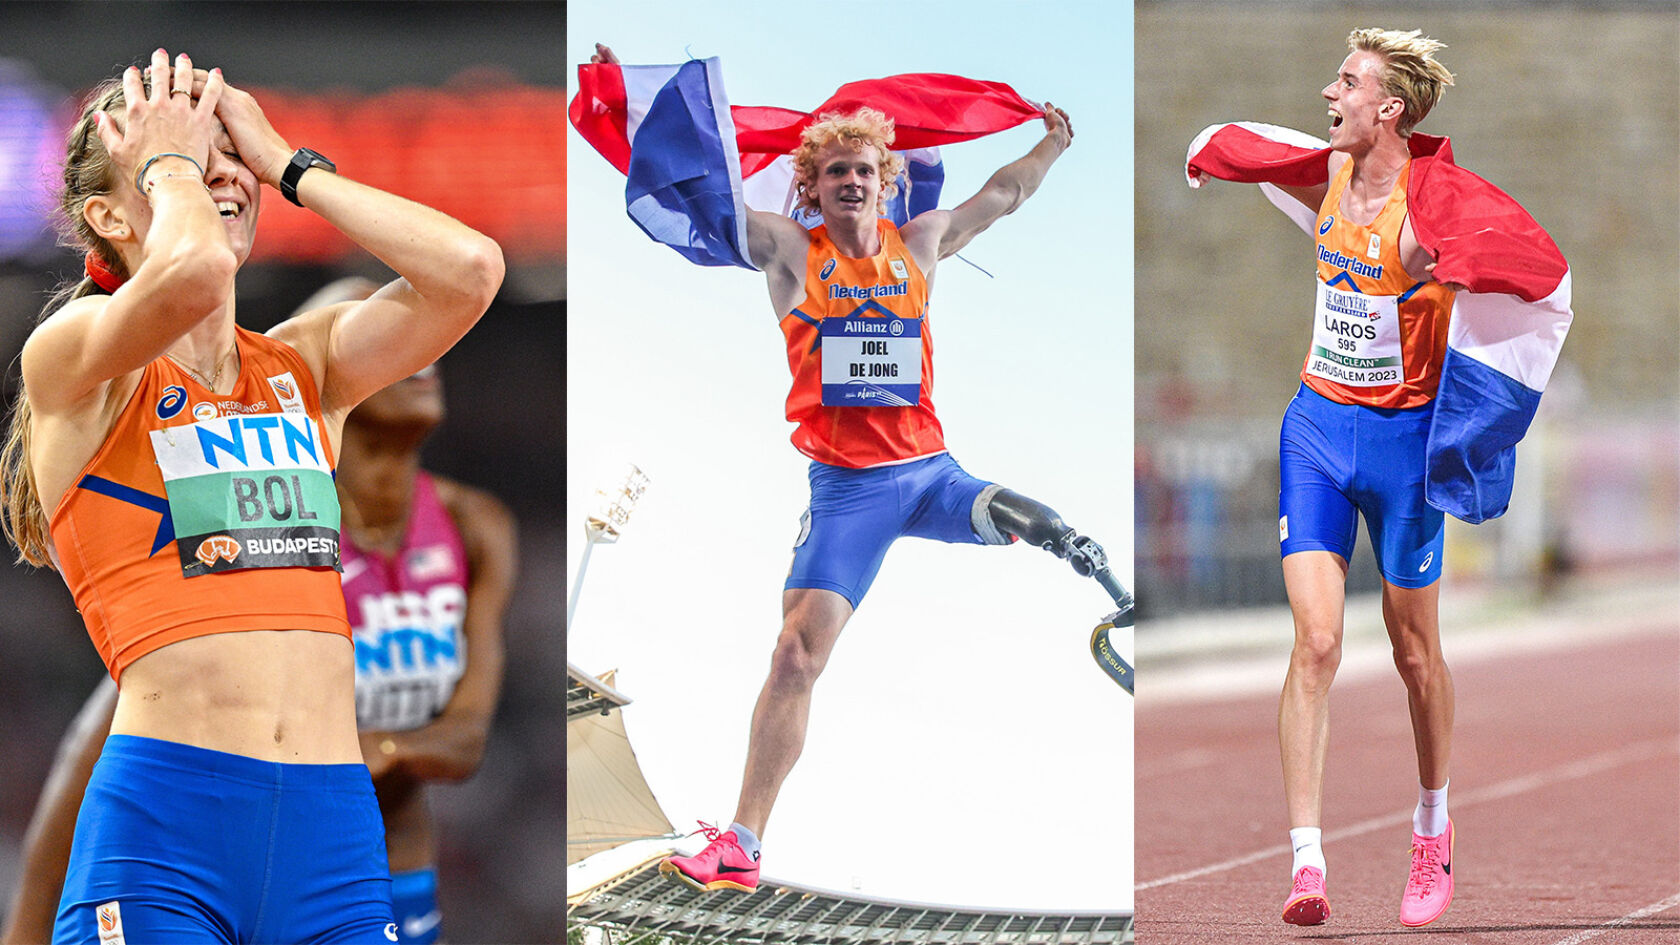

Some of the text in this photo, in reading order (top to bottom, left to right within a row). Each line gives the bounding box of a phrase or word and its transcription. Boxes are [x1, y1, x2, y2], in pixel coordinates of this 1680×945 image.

[844, 320, 887, 333] Allianz
[1325, 315, 1377, 340] LAROS
[861, 341, 889, 355] JOEL
[1338, 338, 1357, 352] 595
[850, 363, 898, 377] DE JONG
[1312, 360, 1398, 382] JERUSALEM 2023
[194, 416, 320, 469] NTN
[232, 475, 317, 522] BOL
